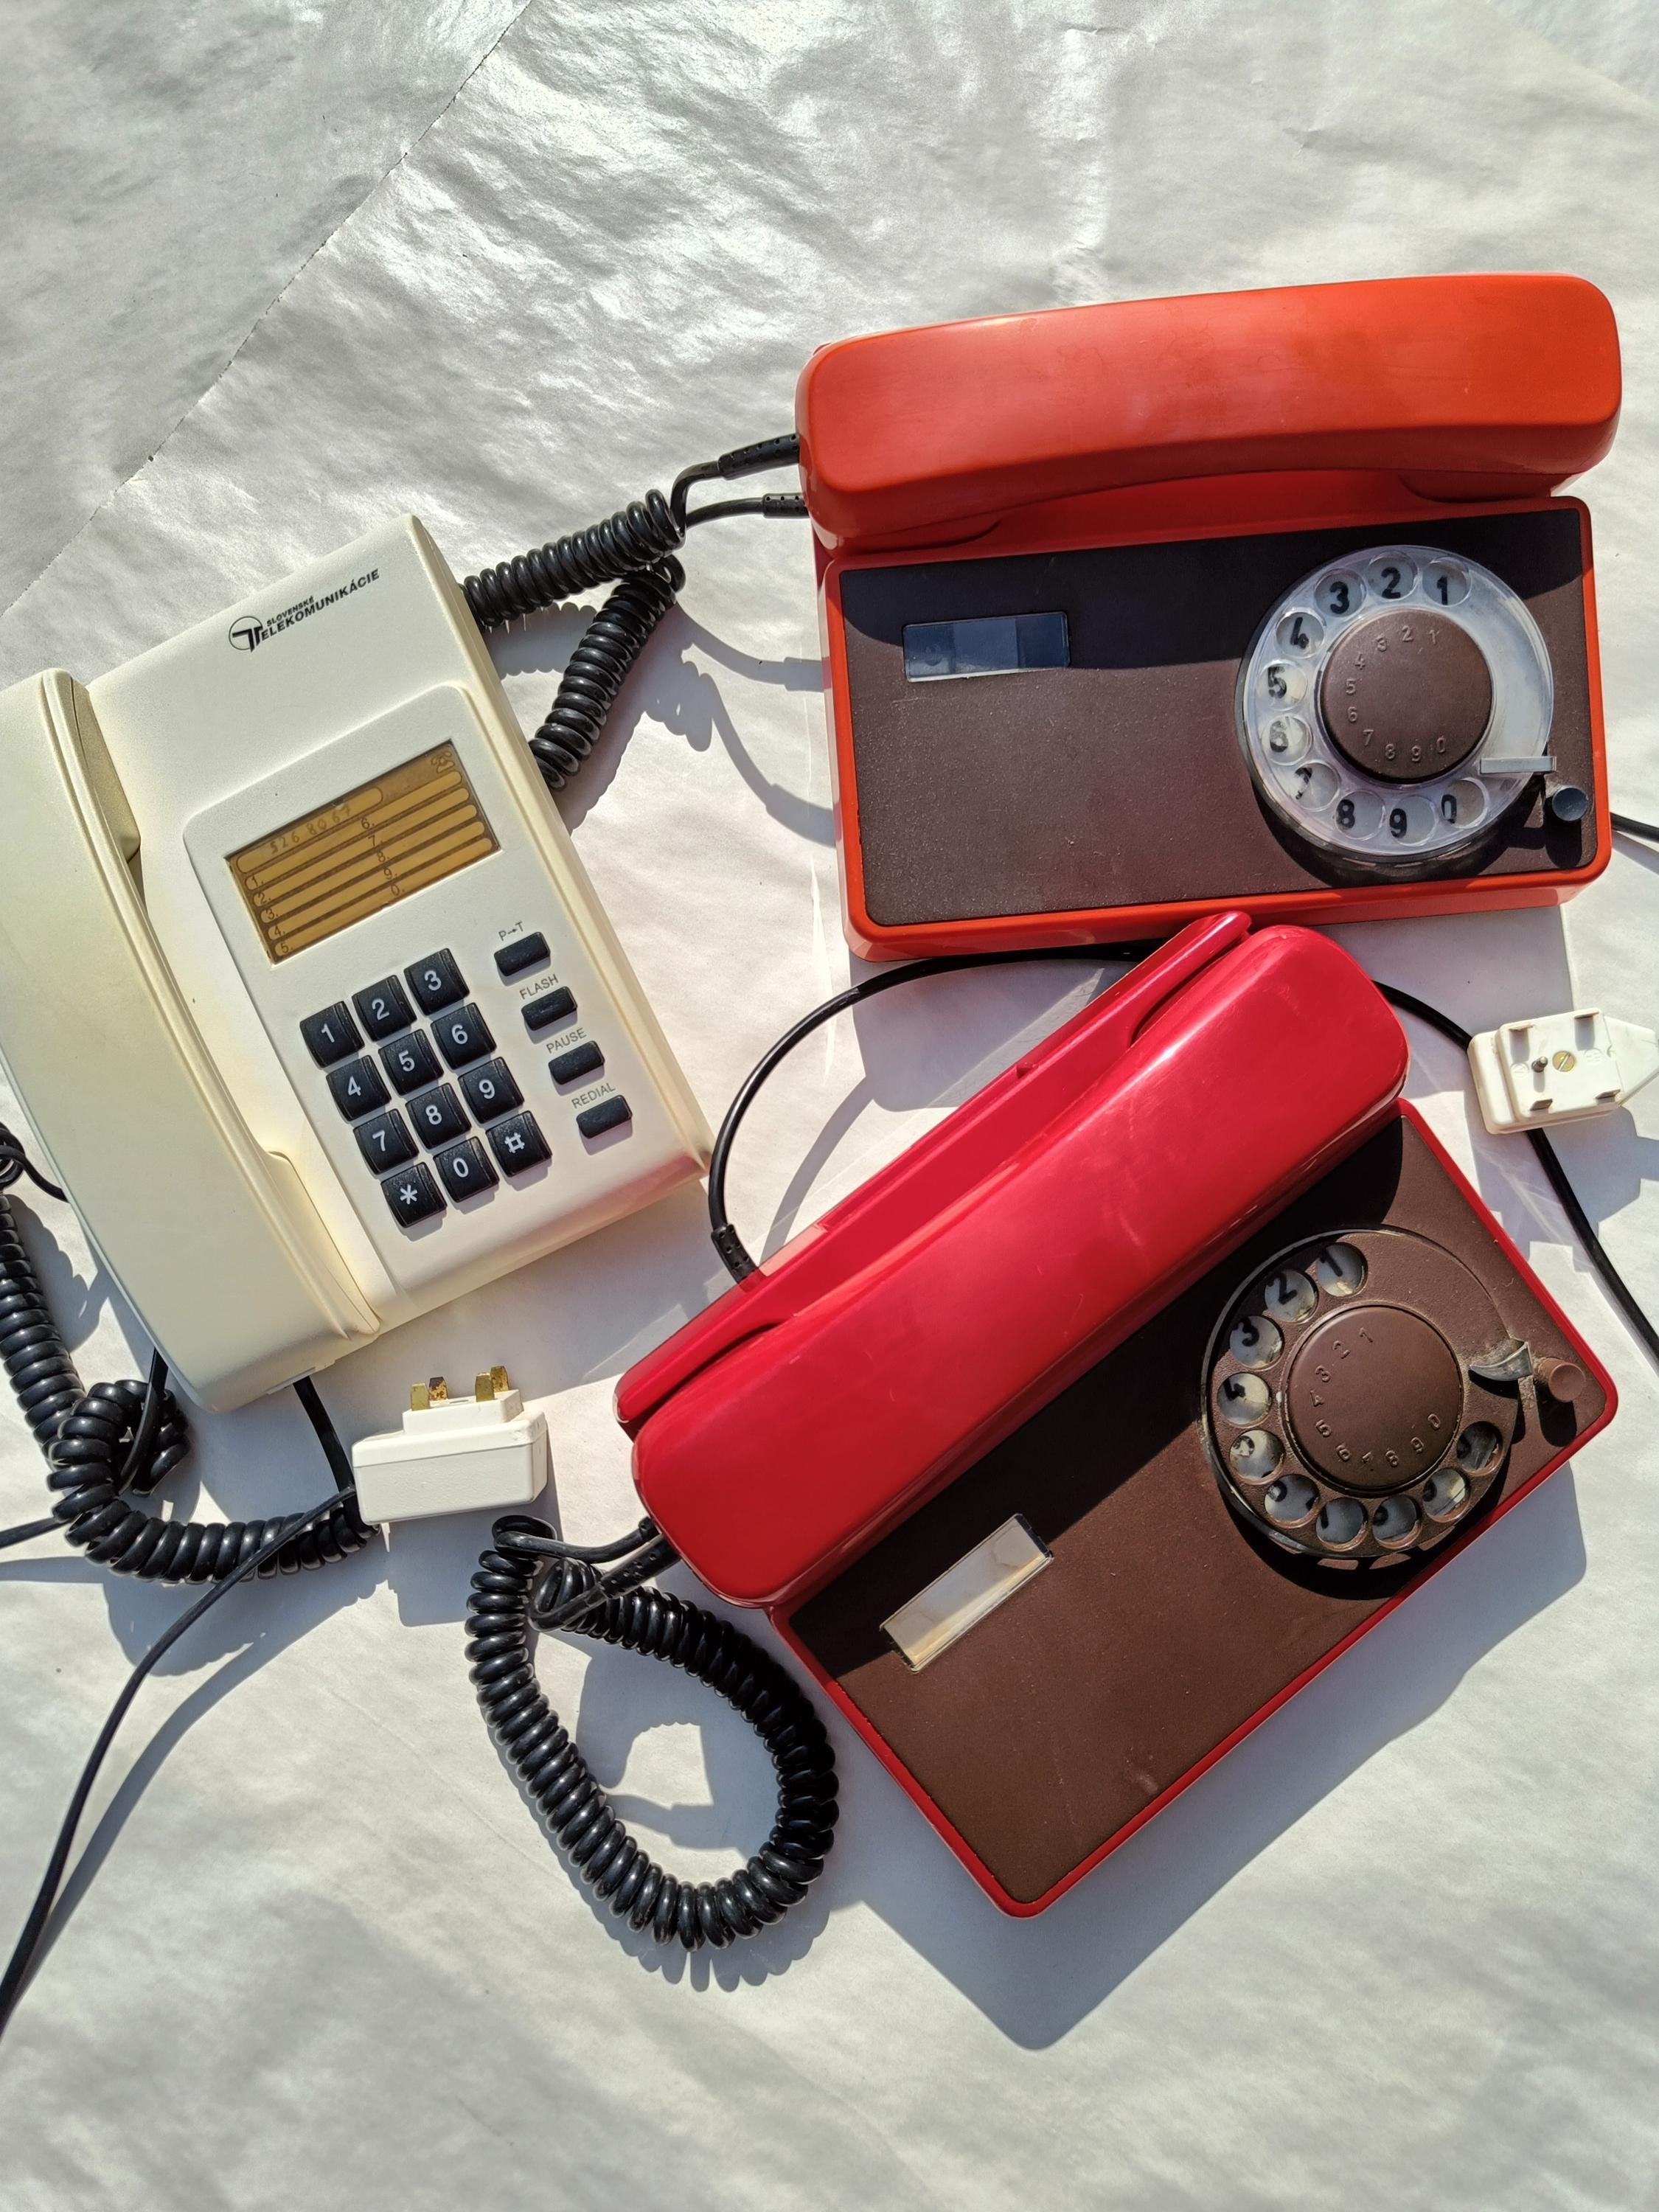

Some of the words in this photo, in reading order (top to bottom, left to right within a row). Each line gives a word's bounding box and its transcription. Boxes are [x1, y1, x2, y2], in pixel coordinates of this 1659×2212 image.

[1380, 566, 1400, 599] 2
[1436, 576, 1448, 605] 1
[1329, 581, 1350, 613] 3
[267, 596, 314, 627] SLOVENSKÉ
[1290, 616, 1309, 648] 4
[1376, 634, 1388, 652] 3
[1402, 625, 1413, 643] 2
[1354, 653, 1366, 671] 4
[1267, 666, 1287, 699] 5
[1346, 678, 1357, 695] 5
[1347, 706, 1357, 723] 6
[1269, 720, 1288, 753] 6
[1363, 728, 1374, 747] 7
[1385, 743, 1396, 760] 8
[1411, 745, 1422, 762] 9
[1335, 799, 1355, 830] 8
[1389, 807, 1408, 838] 9
[519, 973, 559, 1000] FLASH
[321, 1023, 335, 1043] 1
[372, 998, 390, 1020] 2
[424, 970, 442, 992] 3
[546, 1027, 587, 1054] PAUSE
[347, 1076, 361, 1097] 4
[398, 1050, 415, 1072] 5
[451, 1023, 468, 1045] 6
[571, 1082, 616, 1109] REDIAL
[372, 1130, 387, 1152] 7
[425, 1104, 442, 1126] 8
[479, 1079, 495, 1099] 9
[453, 1156, 469, 1178] 0
[1315, 1365, 1331, 1383] 3
[1315, 1419, 1332, 1438] 5
[1336, 1442, 1351, 1461] 6
[1385, 1449, 1399, 1468] 8
